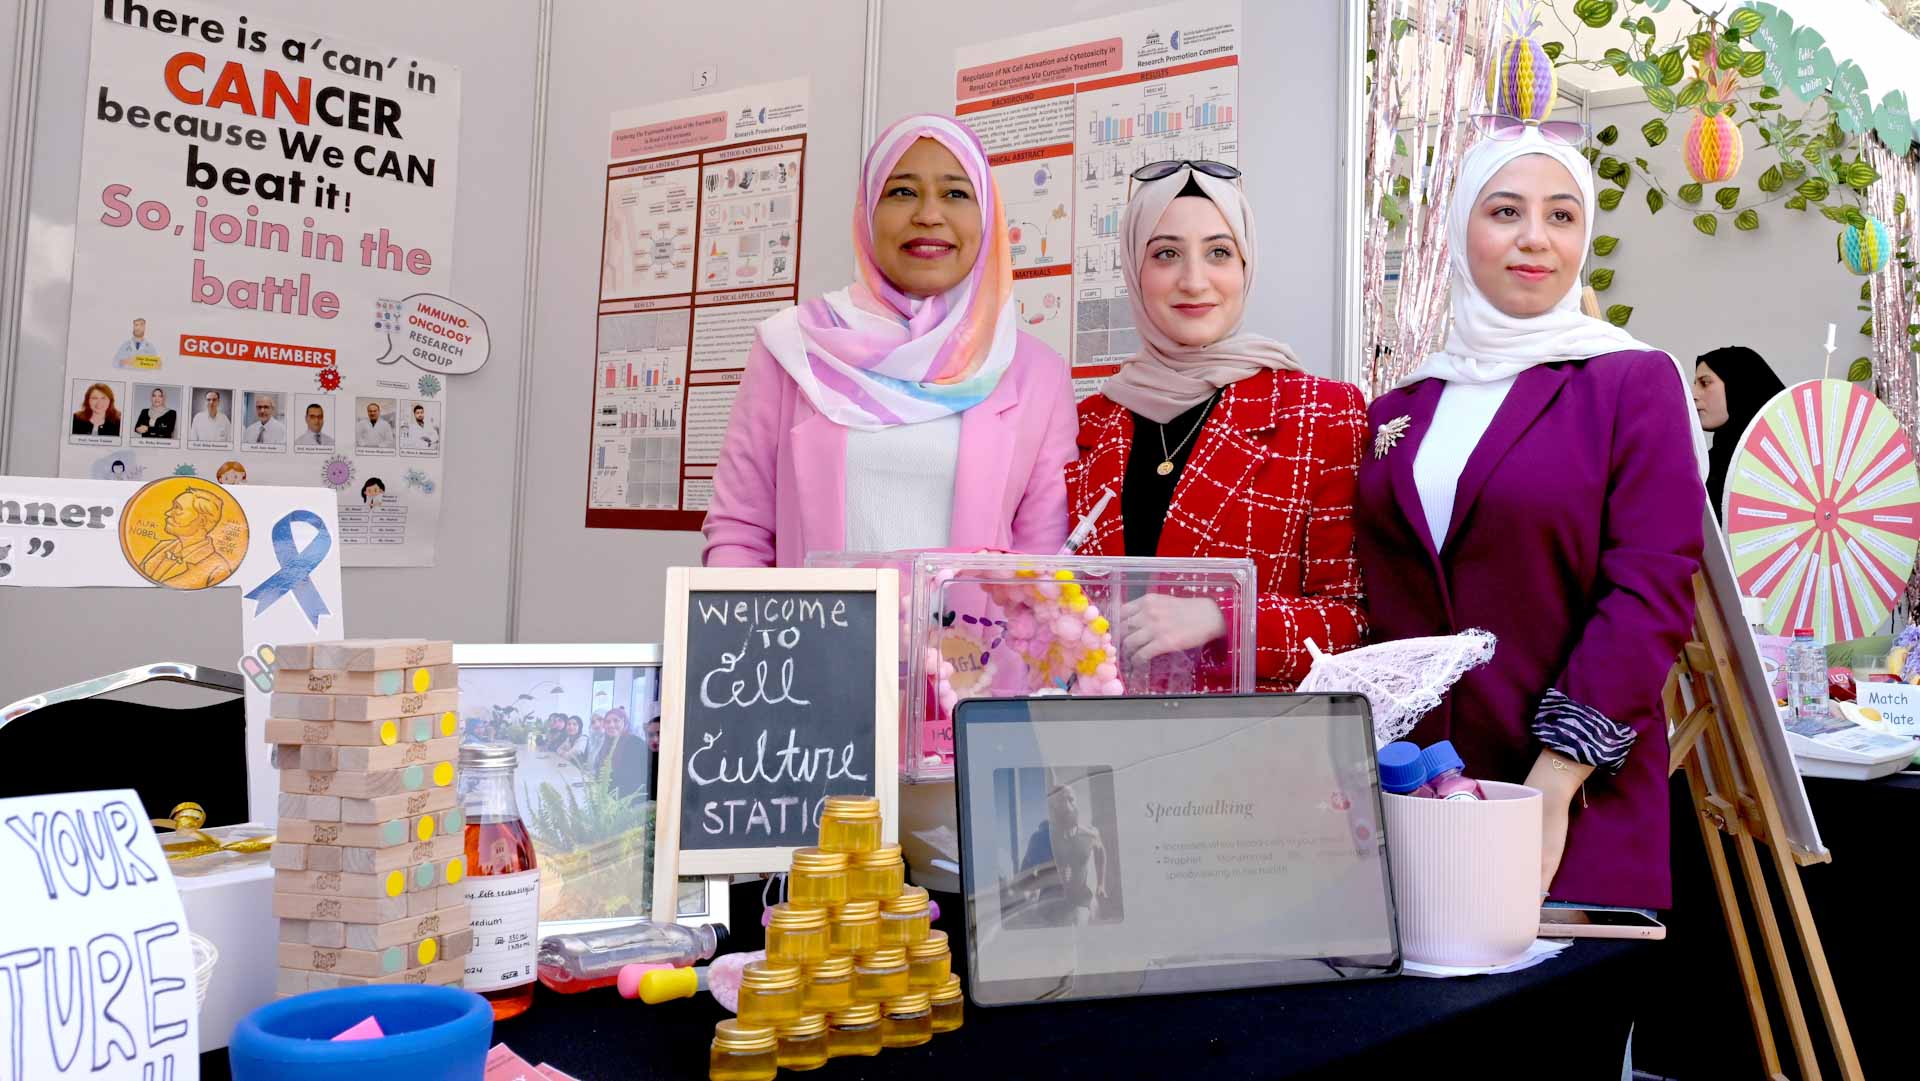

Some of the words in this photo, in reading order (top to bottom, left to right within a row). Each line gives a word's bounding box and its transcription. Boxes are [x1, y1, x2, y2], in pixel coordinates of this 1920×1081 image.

[104, 0, 225, 43] There
[237, 16, 267, 54] is
[407, 61, 436, 94] in
[962, 71, 994, 84] Regulation
[1012, 63, 1023, 72] Cell
[1024, 57, 1055, 70] Activation
[1056, 54, 1069, 63] and
[1069, 48, 1108, 61] Cytotoxicity
[1137, 57, 1165, 68] Research
[1165, 51, 1198, 62] Promotion
[1199, 44, 1234, 56] Committee
[164, 51, 403, 139] CANCER
[969, 82, 986, 91] Renal
[987, 79, 999, 88] Cell
[999, 74, 1030, 86] Carcinoma
[1031, 71, 1041, 79] Via
[1042, 66, 1073, 77] Curcumin
[1073, 59, 1108, 71] Treatment
[97, 86, 267, 150] because
[278, 127, 344, 169] We
[353, 145, 436, 187] CAN
[186, 144, 306, 204] beat
[101, 183, 184, 236] So,
[193, 195, 290, 252] join
[301, 216, 344, 262] in
[360, 228, 432, 275] the
[191, 258, 340, 319] battle
[183, 338, 249, 357] GROUP
[254, 345, 332, 366] MEMBERS
[408, 315, 472, 344] ONCOLOGY
[409, 330, 464, 357] RESEARCH
[412, 347, 453, 367] GROUP
[755, 626, 800, 649] TO
[700, 650, 812, 709] Cell
[1868, 692, 1908, 704] Match
[688, 728, 868, 786] Culture
[5, 800, 158, 899] YOUR
